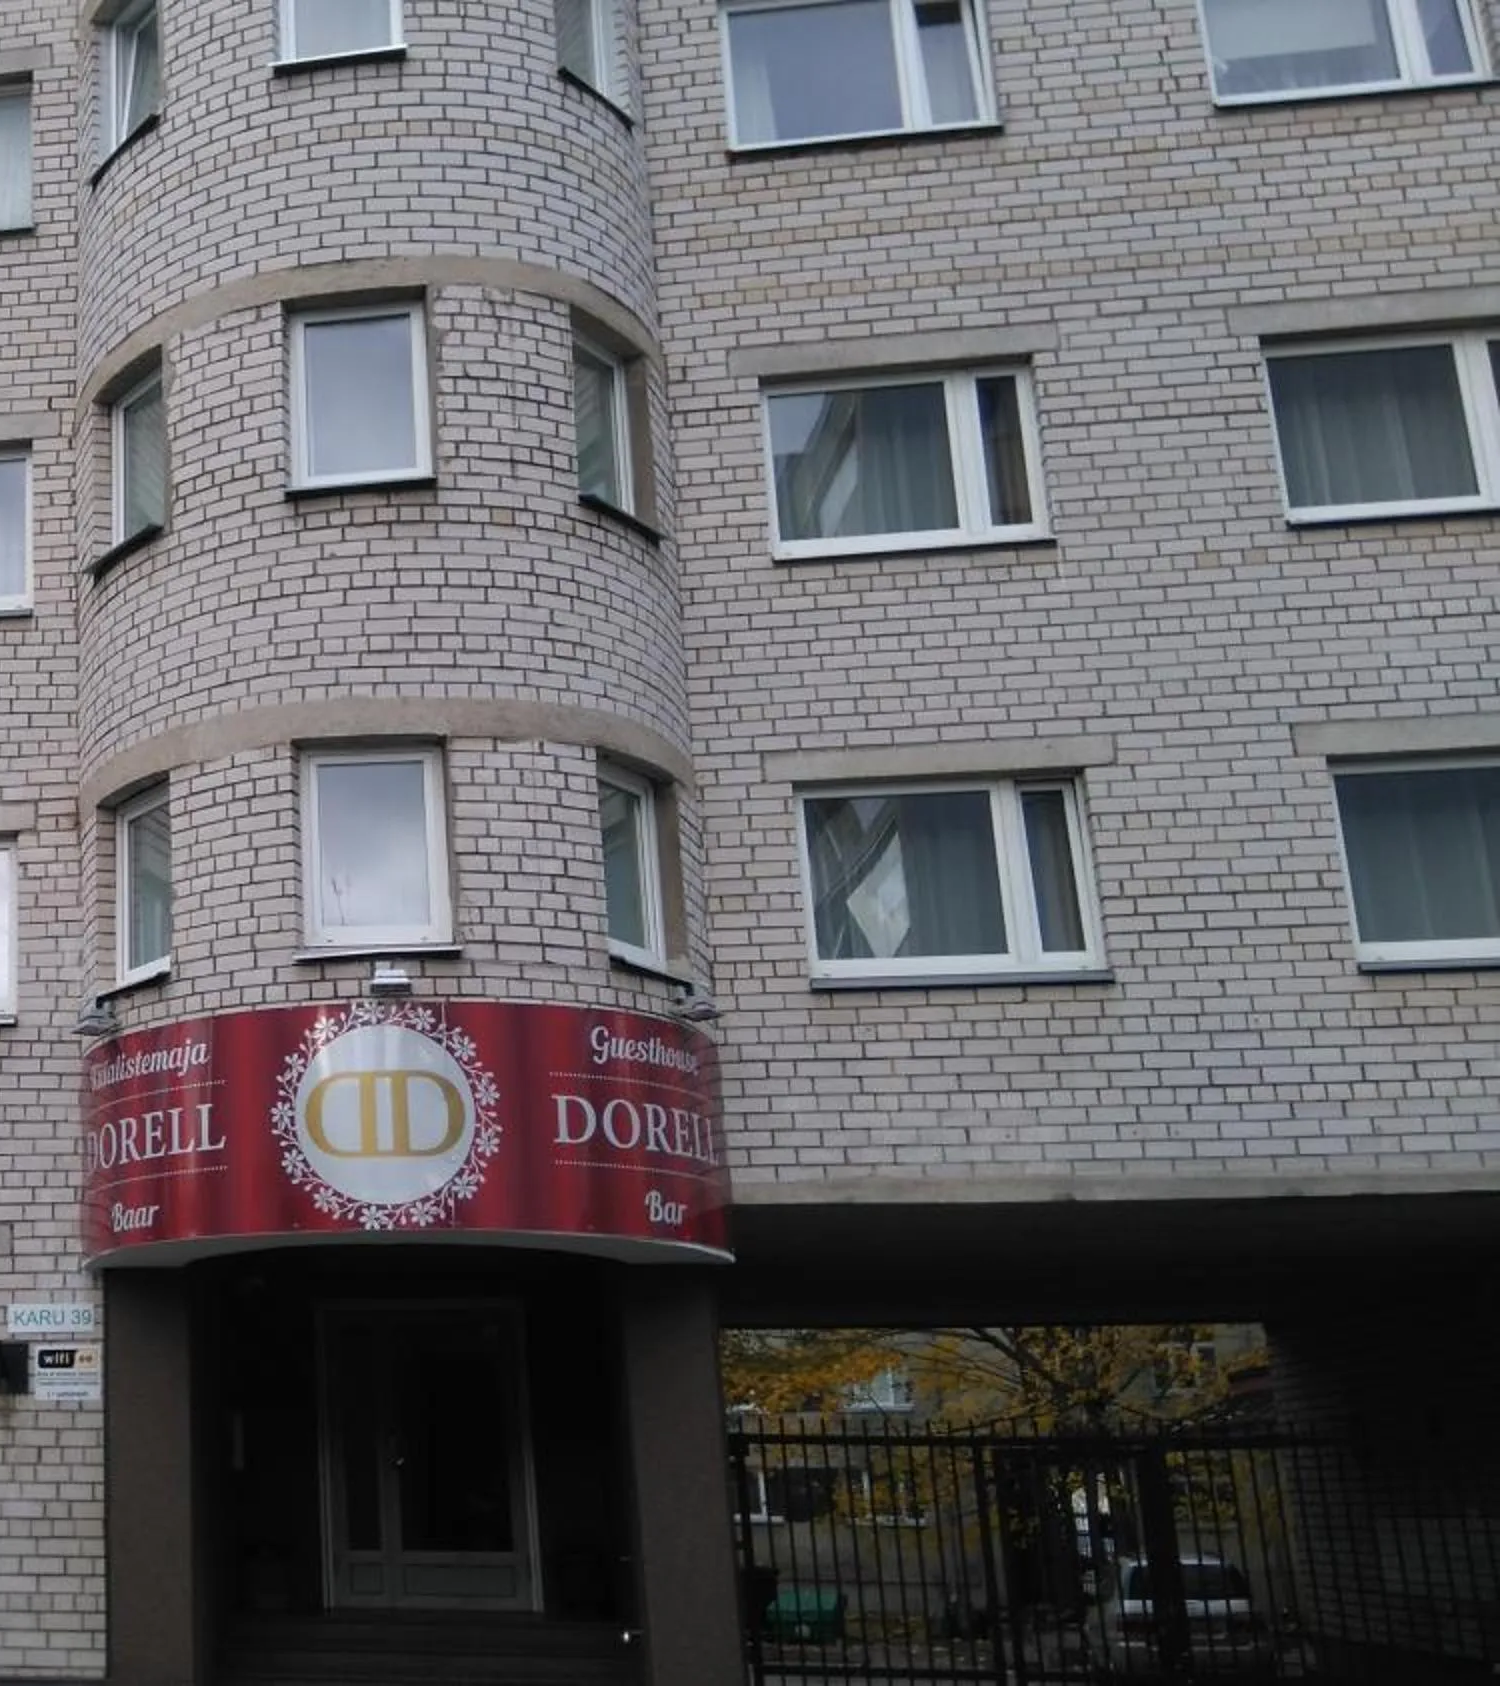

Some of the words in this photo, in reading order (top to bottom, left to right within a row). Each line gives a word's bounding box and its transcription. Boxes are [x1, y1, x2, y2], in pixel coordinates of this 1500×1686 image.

[590, 1025, 701, 1075] Guesthouse
[86, 1103, 227, 1175] DORELL
[551, 1094, 719, 1167] DORELL
[111, 1201, 160, 1233] Baar
[645, 1189, 688, 1225] Bar
[13, 1308, 65, 1326] KARU
[71, 1310, 92, 1326] 39
